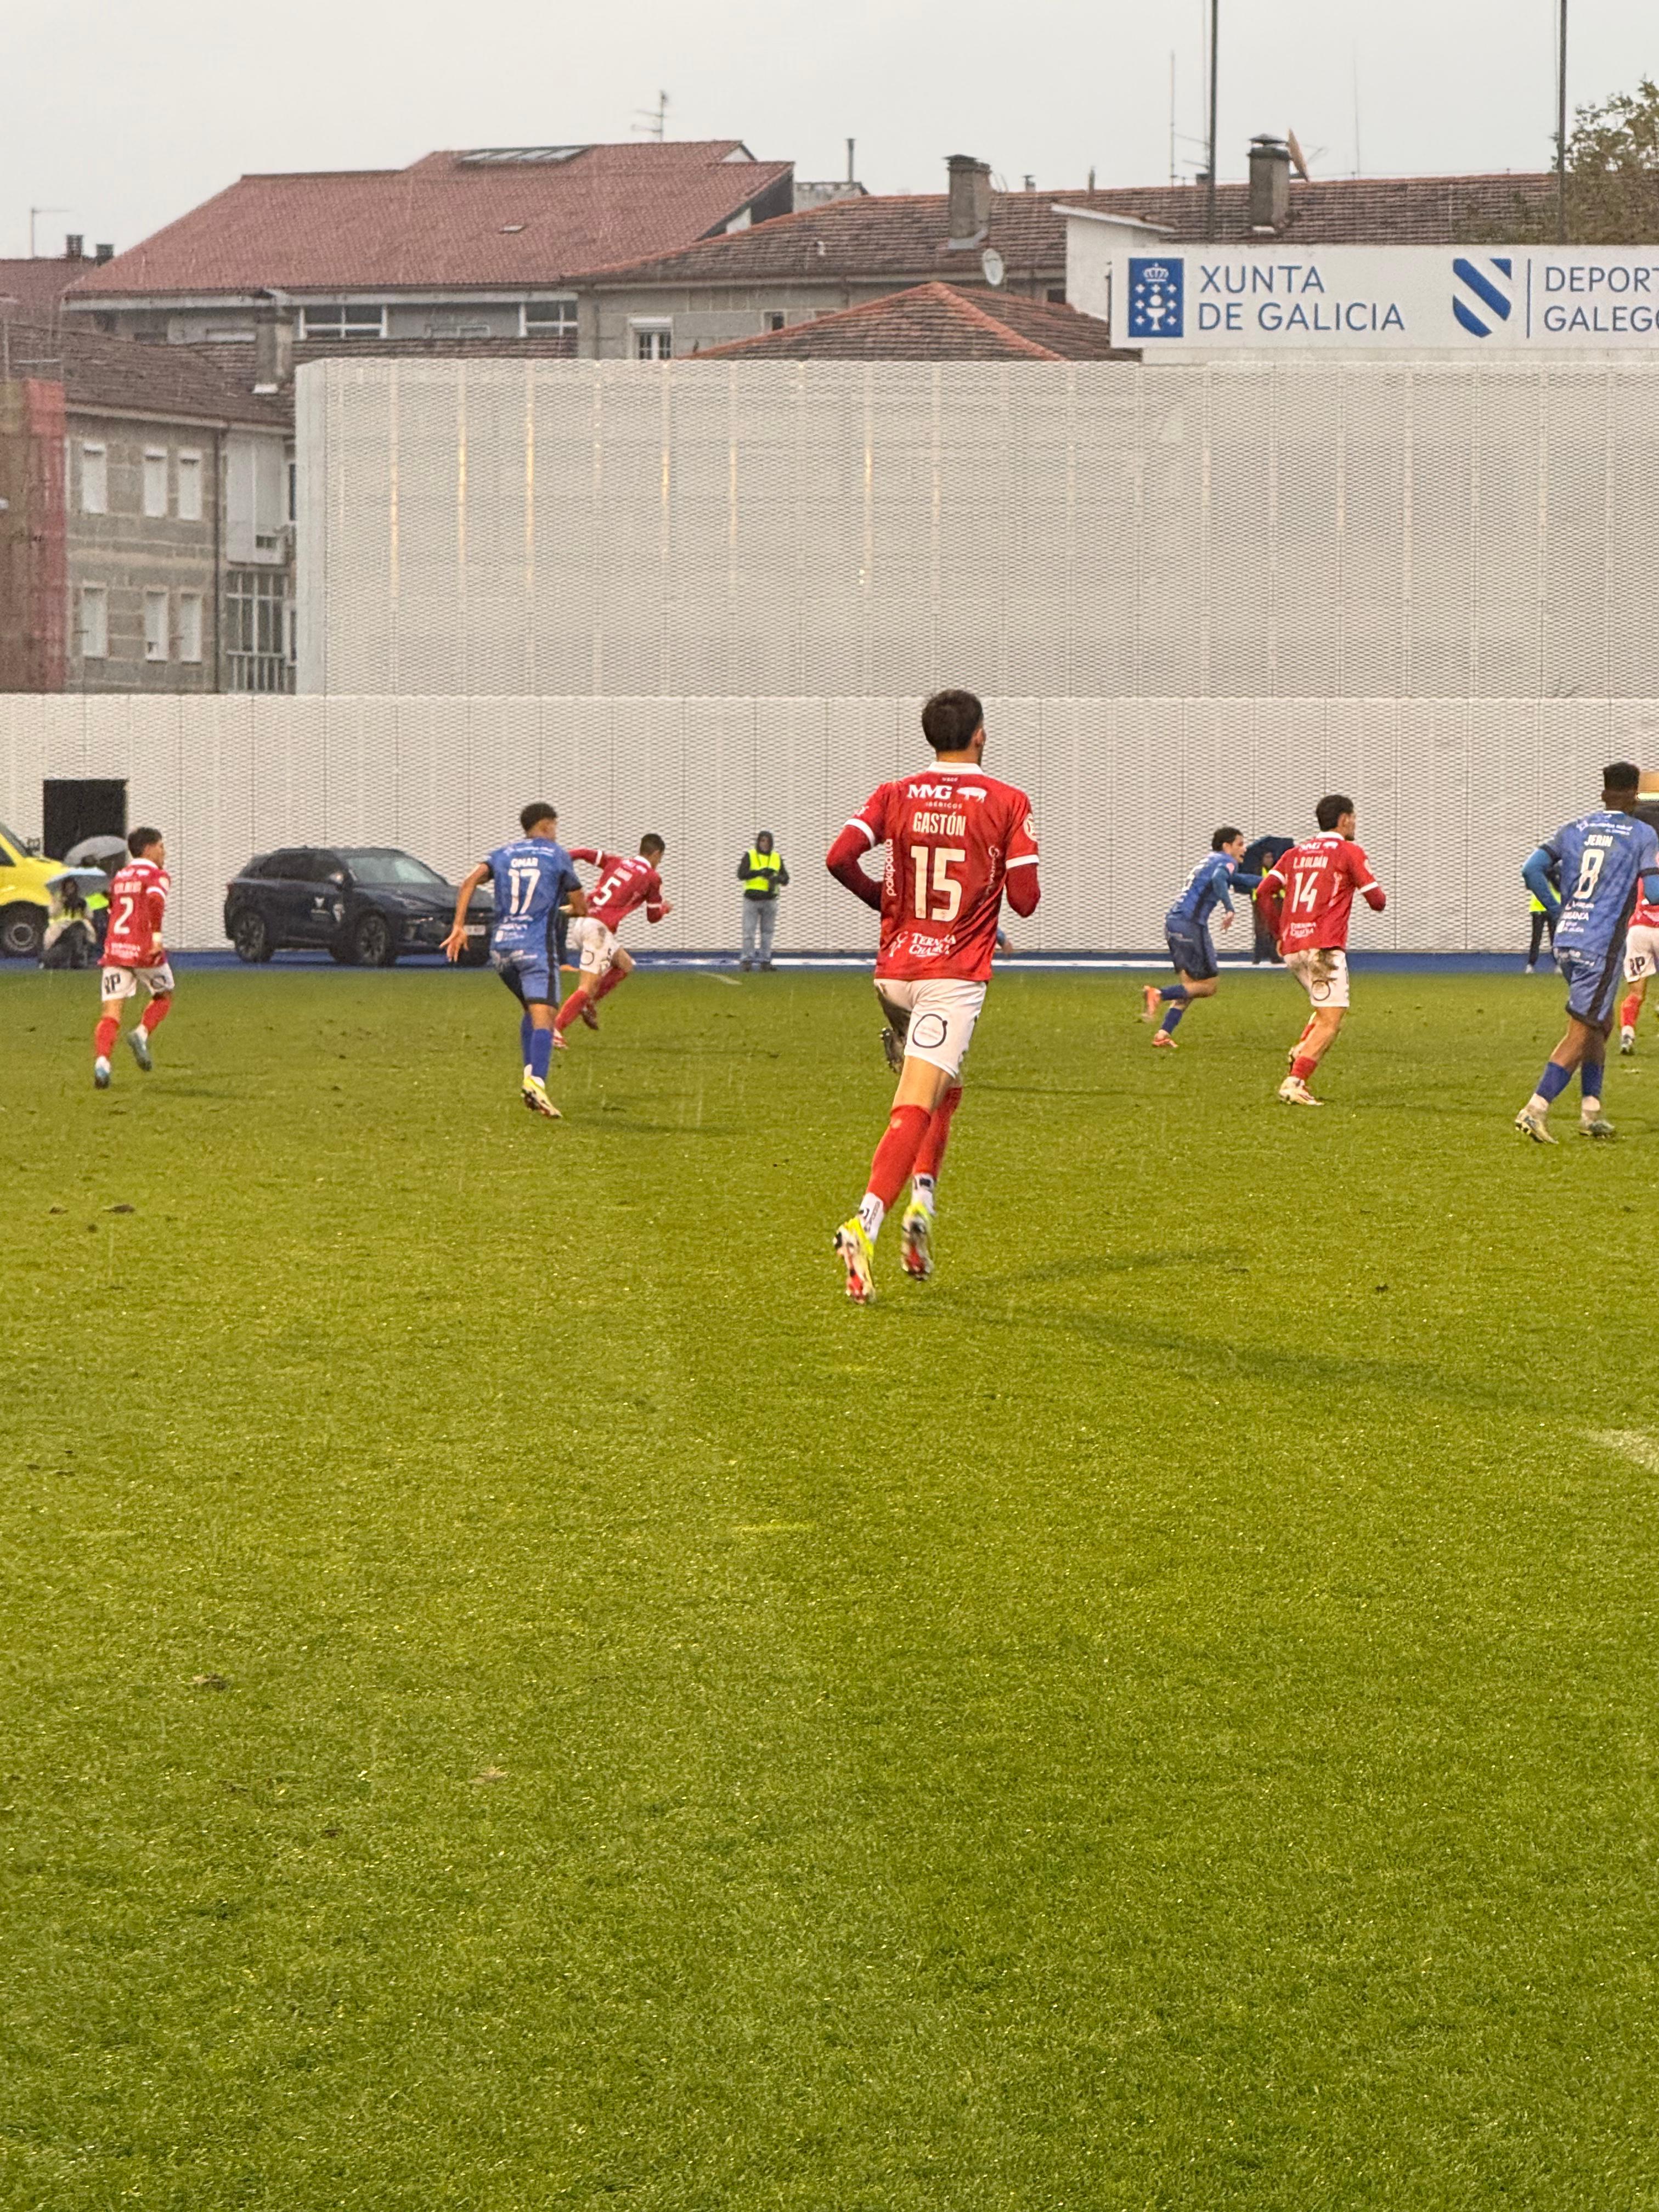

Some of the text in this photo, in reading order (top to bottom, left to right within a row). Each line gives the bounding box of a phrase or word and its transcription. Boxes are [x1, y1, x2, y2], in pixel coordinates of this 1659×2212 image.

[1200, 265, 1325, 294] XUNTA
[1198, 302, 1405, 330] DE GALICIA
[1544, 305, 1659, 332] GALEG
[907, 784, 953, 799] MMG
[912, 811, 966, 836] GASTÓN
[1584, 834, 1613, 847] JERIN
[510, 857, 539, 868] OMAR
[1573, 848, 1605, 899] 8
[508, 868, 540, 915] 17
[592, 877, 622, 906] 5
[910, 845, 966, 922] 15
[1291, 871, 1319, 913] 14
[113, 896, 134, 934] 2
[912, 932, 956, 946] TERNA
